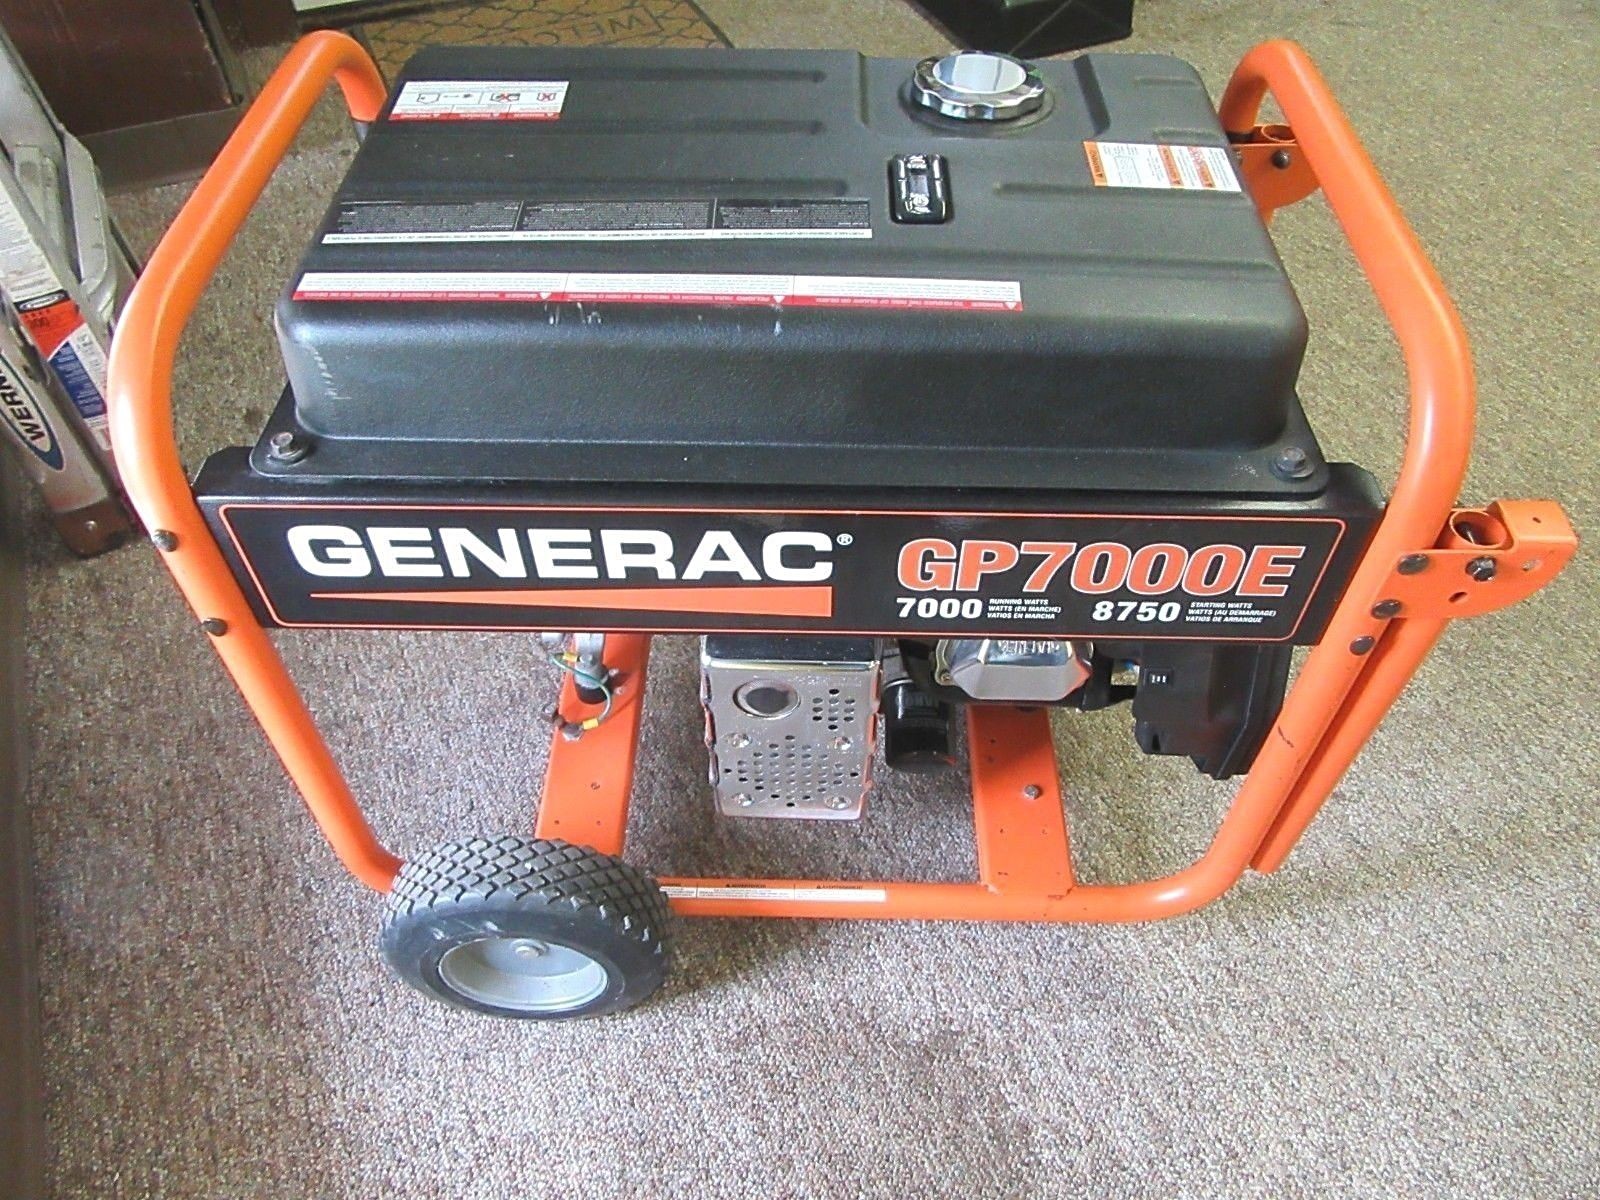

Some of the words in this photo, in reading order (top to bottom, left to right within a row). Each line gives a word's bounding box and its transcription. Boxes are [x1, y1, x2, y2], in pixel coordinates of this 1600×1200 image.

[897, 538, 1306, 597] GP7000E
[896, 597, 983, 619] 7000
[1092, 600, 1181, 622] 8750
